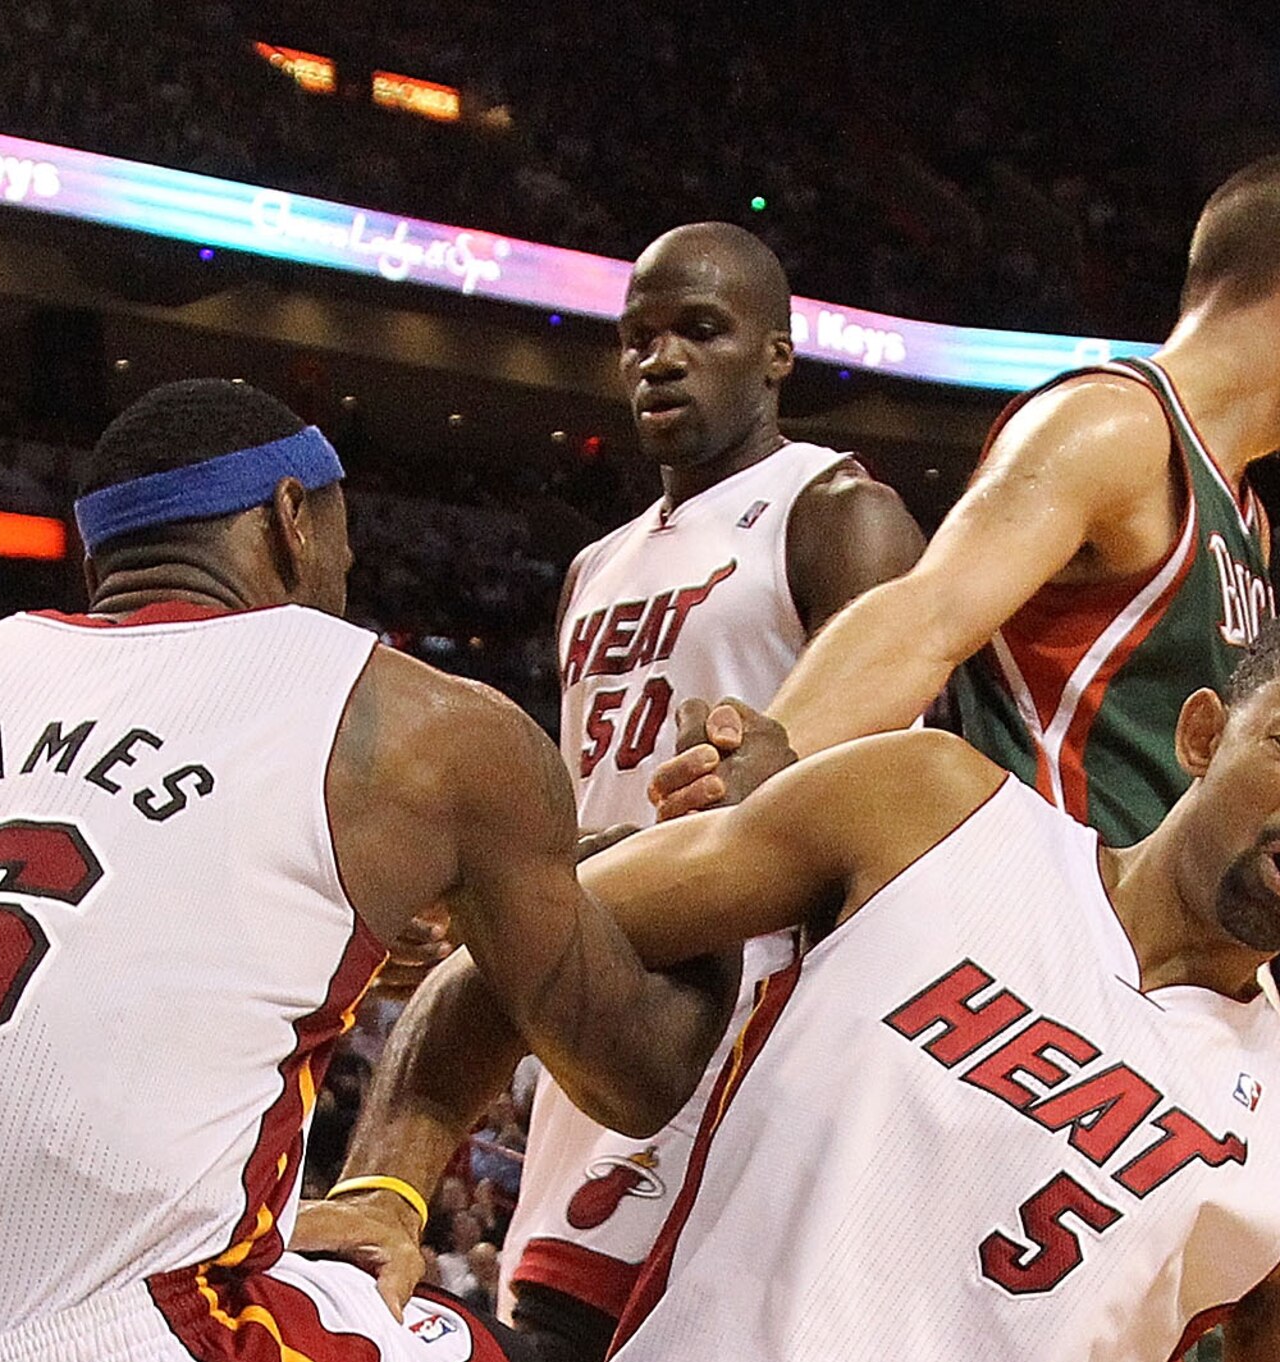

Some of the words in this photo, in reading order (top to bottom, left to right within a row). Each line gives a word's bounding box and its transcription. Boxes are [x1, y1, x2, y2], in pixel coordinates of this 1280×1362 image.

[817, 311, 906, 367] Keys
[561, 556, 738, 688] HEAT
[580, 677, 674, 780] 50
[881, 956, 1249, 1200] HEAT
[978, 1168, 1126, 1296] 5
